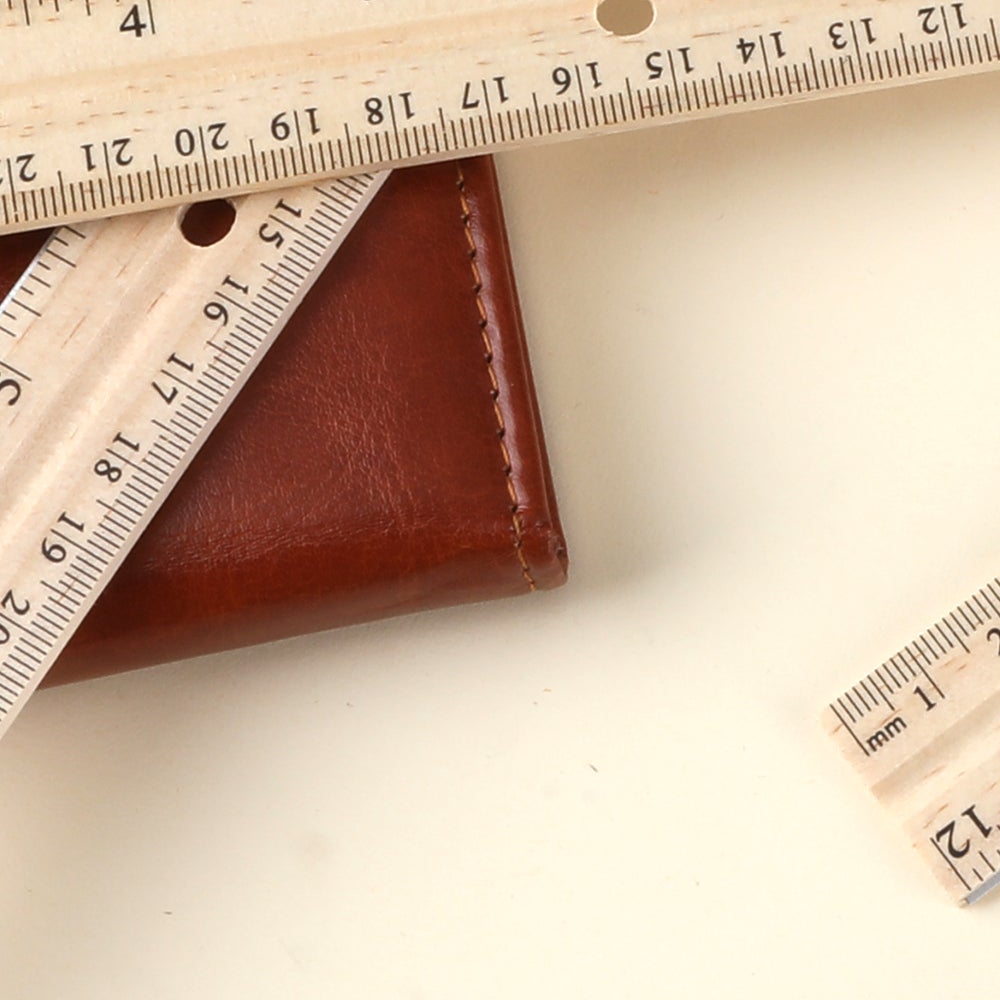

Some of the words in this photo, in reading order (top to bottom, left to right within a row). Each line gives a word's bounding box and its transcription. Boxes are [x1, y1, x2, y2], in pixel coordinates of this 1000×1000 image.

[119, 4, 146, 37] 4
[828, 18, 877, 50] 13
[918, 2, 968, 34] 12
[645, 46, 695, 80] 15
[736, 31, 786, 64] 14
[461, 76, 509, 110] 17
[552, 62, 602, 95] 16
[271, 107, 322, 140] 19
[364, 92, 415, 126] 18
[80, 138, 134, 173] 21
[175, 122, 230, 156] 20
[0, 154, 37, 184] 2
[259, 199, 302, 249] 15
[203, 275, 249, 325] 16
[152, 352, 194, 405] 17
[94, 432, 140, 483] 18
[41, 512, 85, 562] 19
[866, 714, 908, 753] mm
[913, 685, 937, 711] 1
[936, 804, 993, 859] 12
